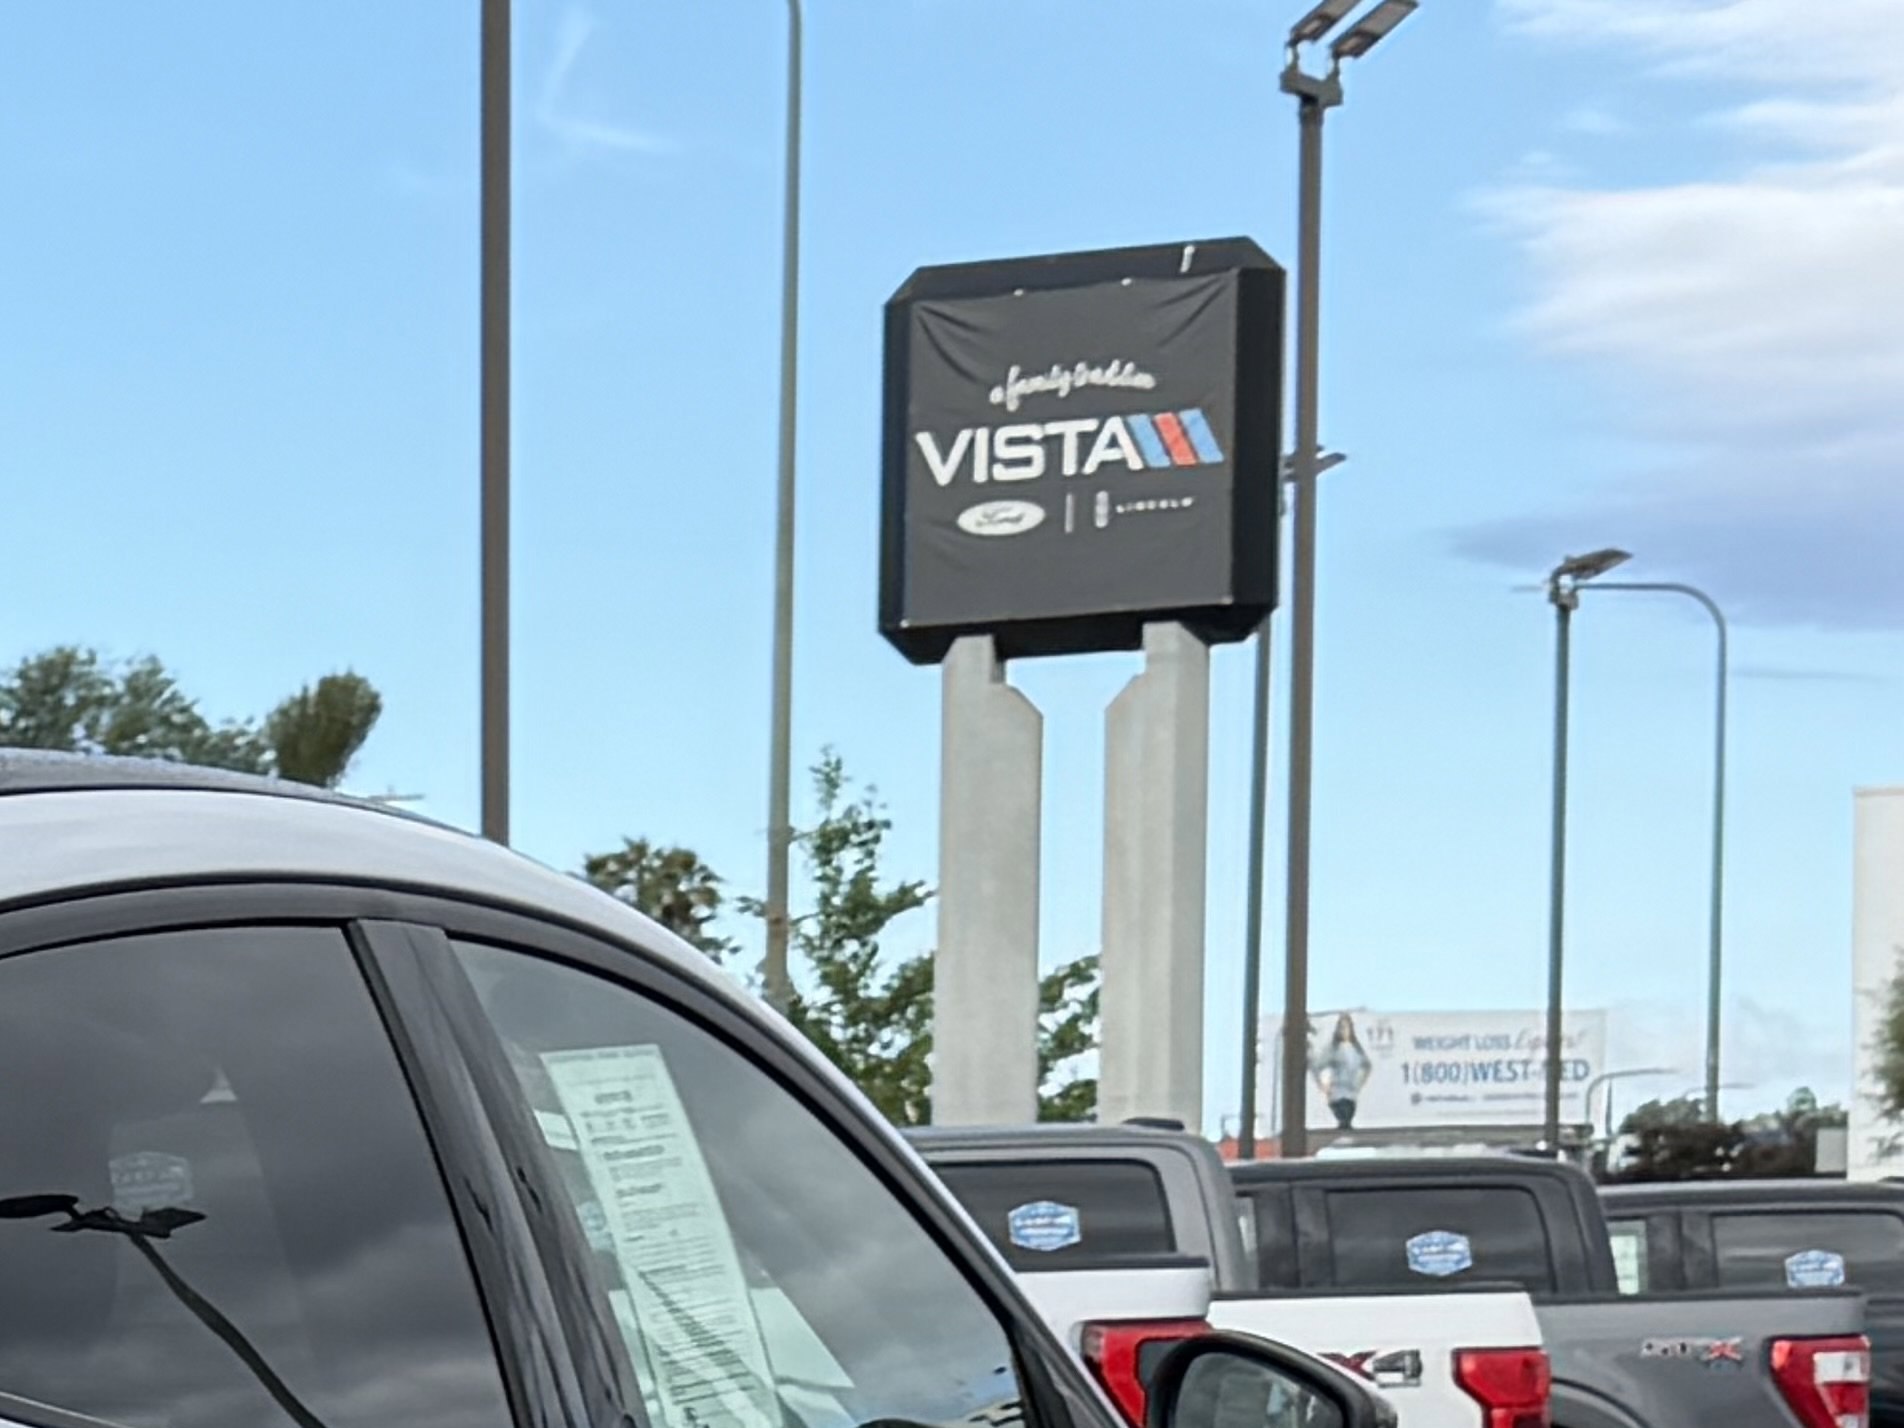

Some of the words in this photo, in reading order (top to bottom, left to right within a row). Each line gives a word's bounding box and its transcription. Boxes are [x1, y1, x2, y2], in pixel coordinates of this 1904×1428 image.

[916, 416, 1143, 487] VISTA
[1401, 1058, 1591, 1085] 1(800)WEST-ED
[1317, 1349, 1423, 1388] X4
